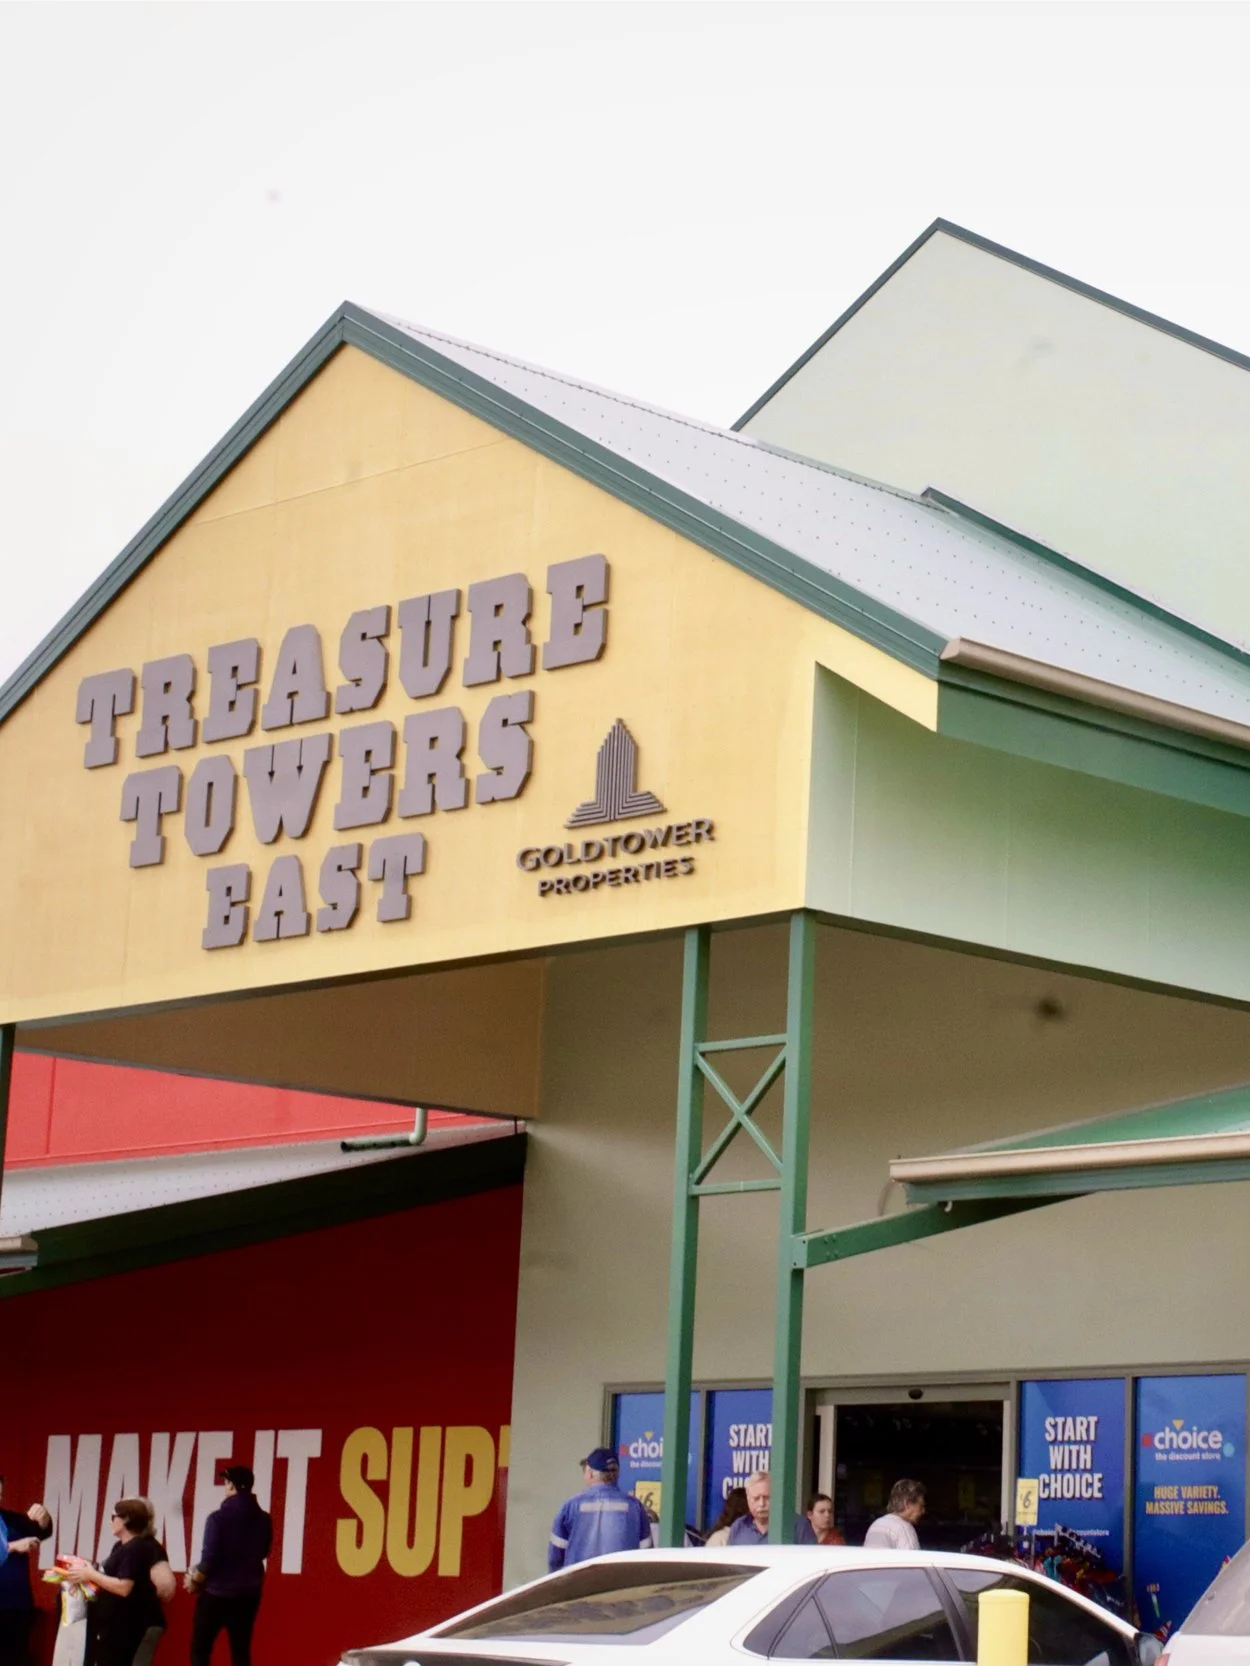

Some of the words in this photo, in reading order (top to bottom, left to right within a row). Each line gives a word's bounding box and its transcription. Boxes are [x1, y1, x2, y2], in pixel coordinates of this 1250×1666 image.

[76, 554, 609, 769] TREASURE
[120, 690, 535, 868] TOWERS
[516, 818, 715, 872] GOLDTOWER
[538, 856, 695, 897] PROPERTIES
[202, 832, 426, 950] EAST
[729, 1423, 773, 1448] START
[1045, 1416, 1098, 1442] START
[1153, 1426, 1223, 1450] choice
[629, 1436, 664, 1458] choi
[1049, 1445, 1092, 1470] WITH
[732, 1450, 771, 1474] WITH
[1039, 1472, 1103, 1500] CHOICE
[1154, 1485, 1179, 1499] HUGE
[1181, 1485, 1221, 1499] VARIETY.
[335, 1426, 510, 1577] SUP
[1145, 1501, 1185, 1515] MASSIVE
[1187, 1500, 1229, 1515] SAVINGS.
